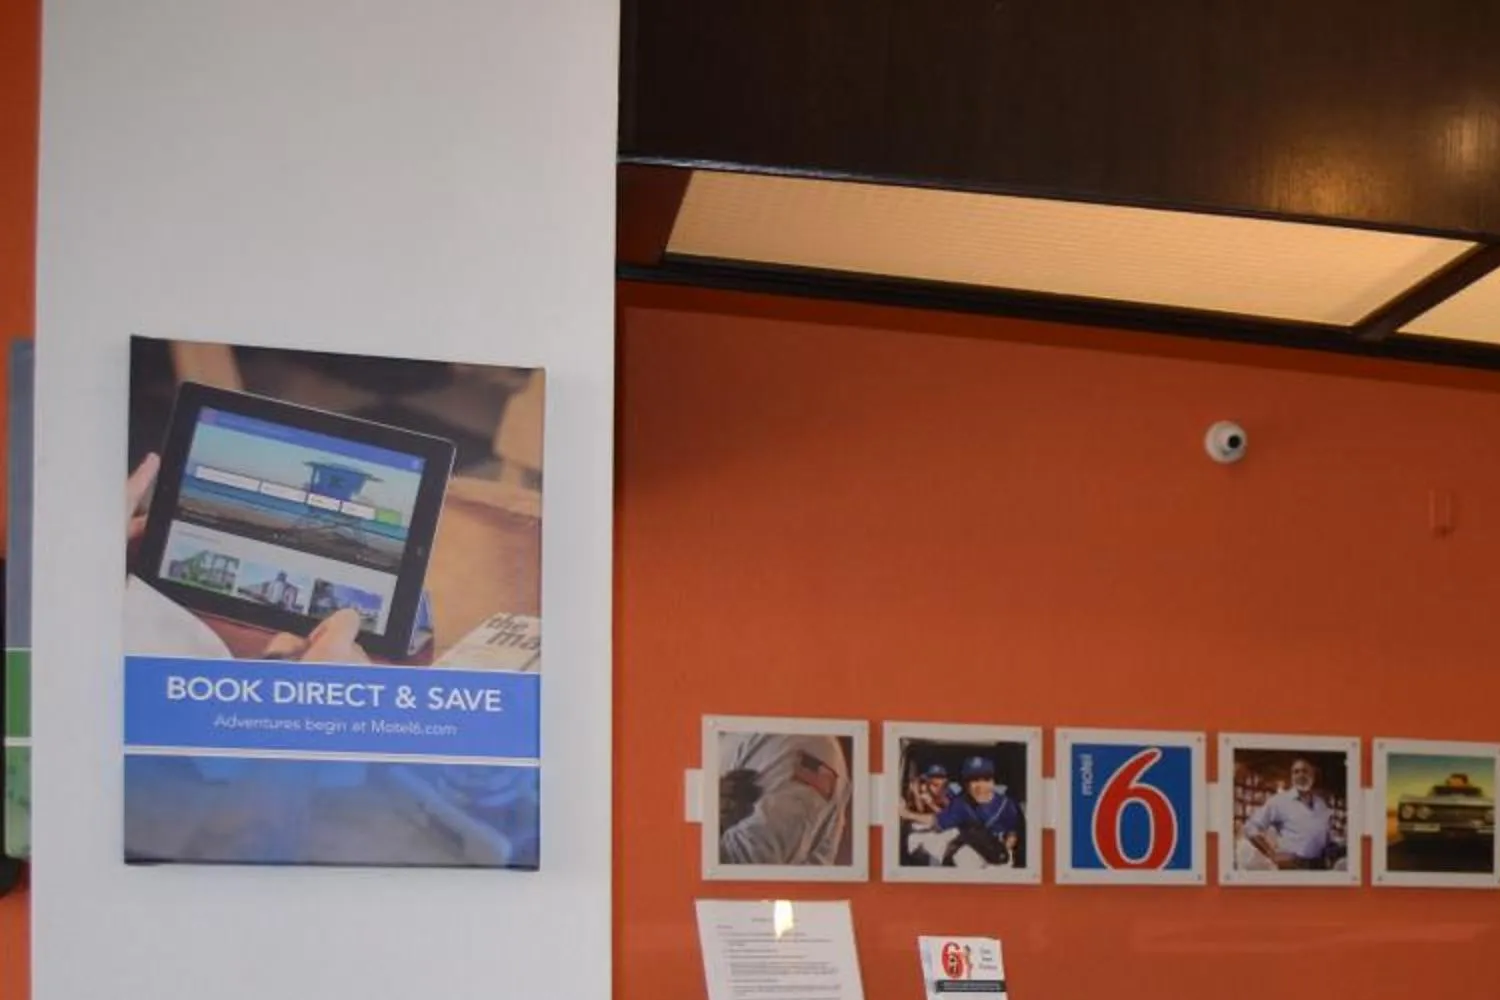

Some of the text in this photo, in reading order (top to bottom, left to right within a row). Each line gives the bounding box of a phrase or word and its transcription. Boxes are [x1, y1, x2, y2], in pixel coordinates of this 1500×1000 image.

[167, 676, 503, 713] BOOK DIRECT & SAVE
[213, 713, 458, 737] Adventures begin at Motel6.com
[1079, 753, 1093, 796] motel
[1091, 747, 1178, 870] 6
